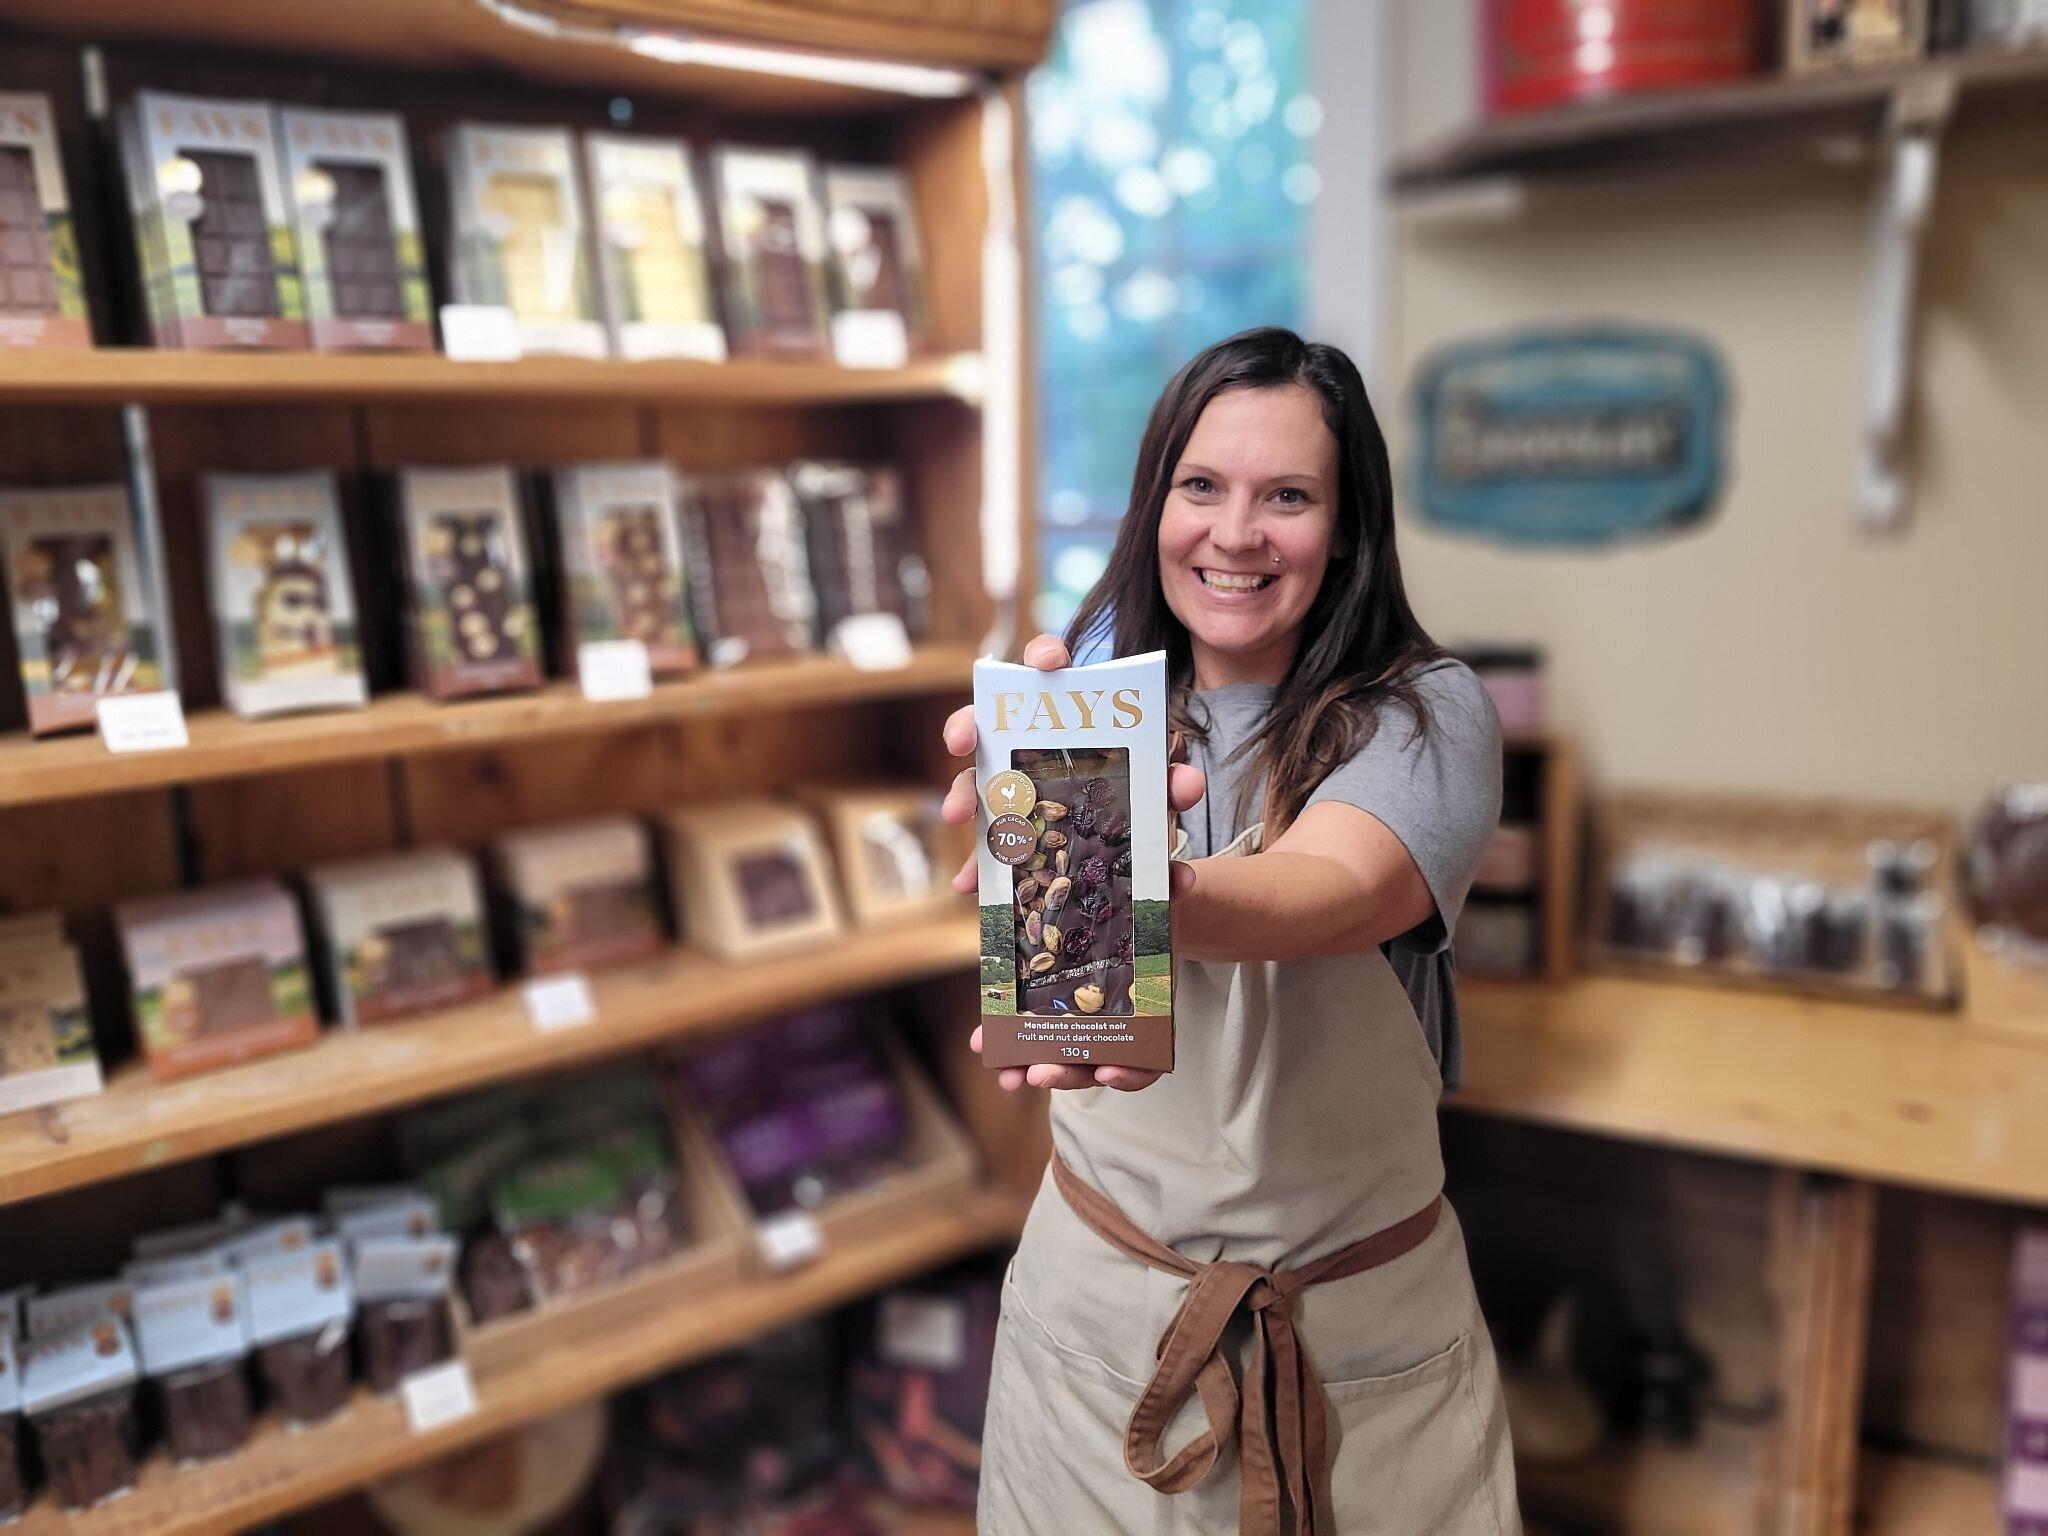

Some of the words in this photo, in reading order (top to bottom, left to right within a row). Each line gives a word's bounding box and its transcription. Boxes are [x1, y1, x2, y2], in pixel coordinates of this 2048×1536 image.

[992, 688, 1144, 732] FAYS
[1005, 773, 1033, 795] CHOCOLATE
[995, 817, 1007, 827] PUR
[1007, 816, 1026, 827] CACAO
[997, 832, 1027, 846] 70%
[995, 851, 1009, 862] PURE
[1009, 852, 1028, 863] COCOA
[1024, 1021, 1069, 1030] Mendiante
[1070, 1021, 1108, 1030] chocolat
[1109, 1022, 1127, 1030] noir
[1017, 1032, 1037, 1041] Fruit
[1038, 1033, 1054, 1041] and
[1056, 1033, 1071, 1041] nut
[1073, 1033, 1092, 1042] dark
[1092, 1033, 1134, 1042] chocolate
[1060, 1047, 1080, 1057] 130
[1082, 1048, 1090, 1059] g
